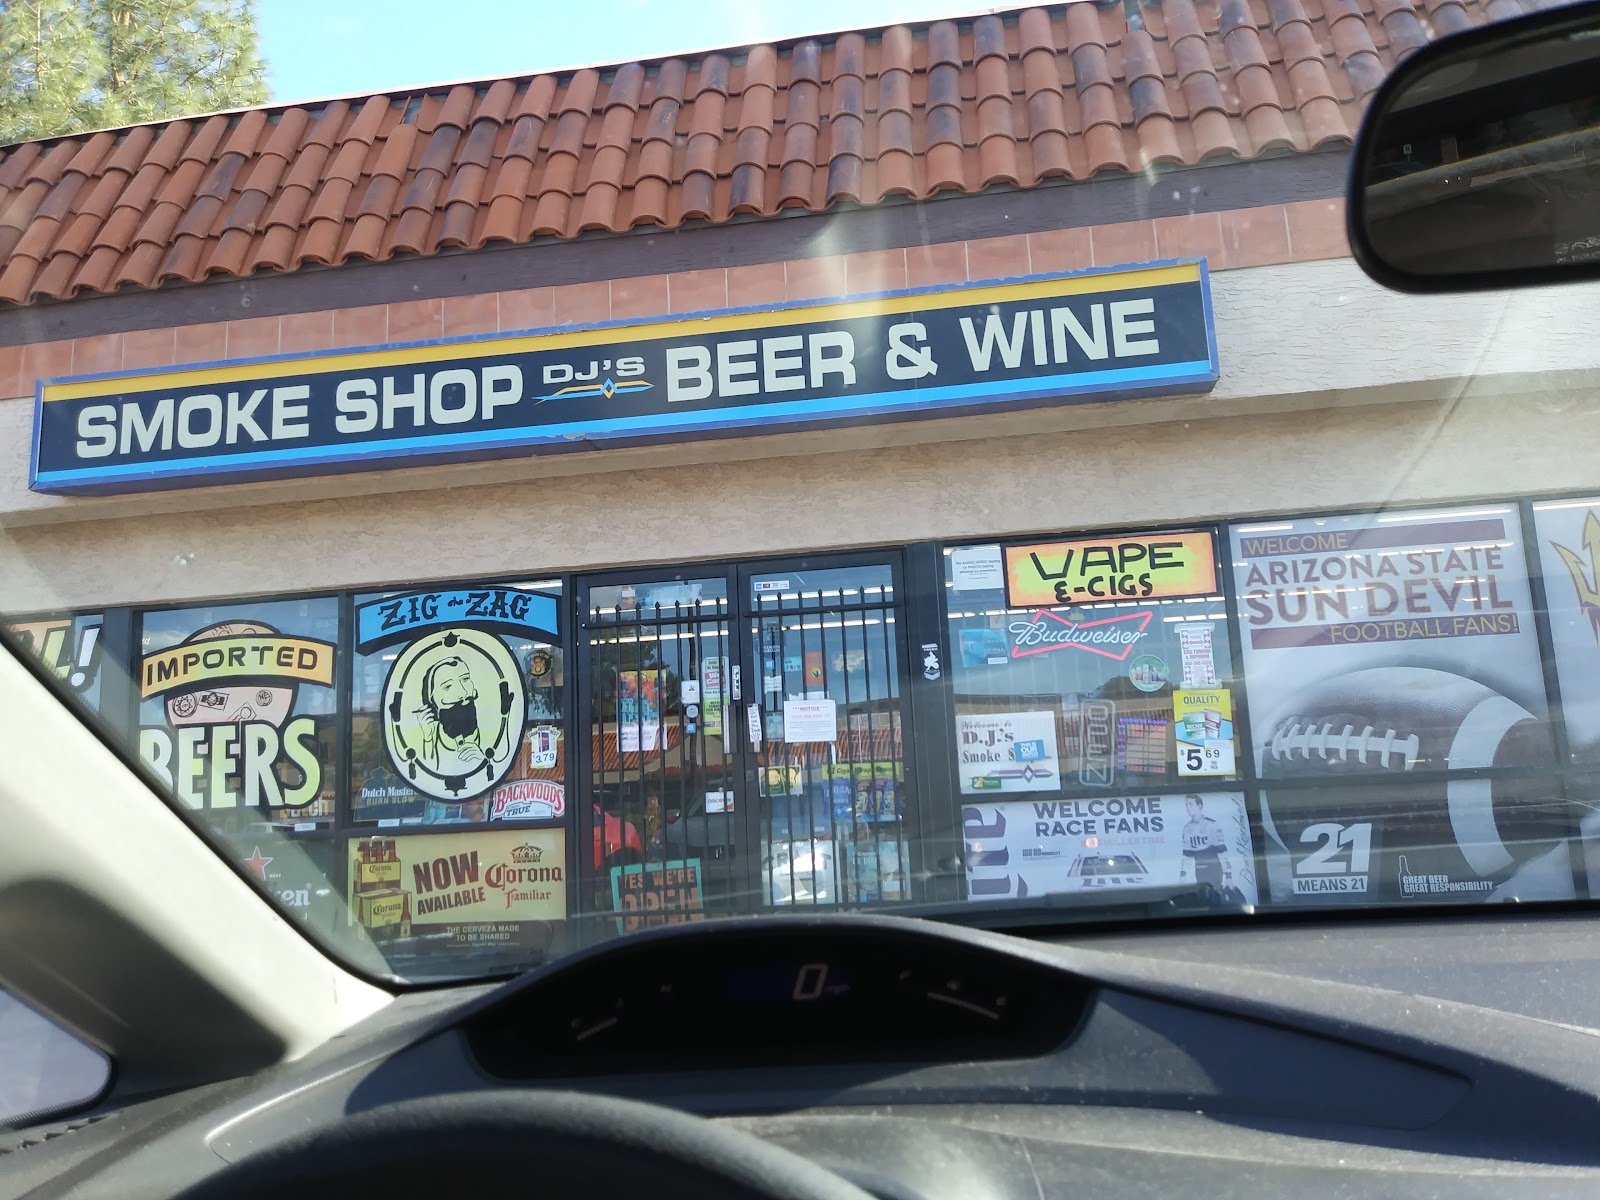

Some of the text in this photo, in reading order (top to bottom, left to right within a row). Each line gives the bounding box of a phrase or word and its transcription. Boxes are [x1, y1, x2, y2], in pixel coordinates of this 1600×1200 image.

[75, 297, 1160, 459] SMOKE SHOP DJ'S BEER & WINE
[1245, 532, 1348, 556] WELCOME
[1029, 541, 1185, 581] VAPE
[1245, 545, 1504, 587] ARIZONA STATE
[1054, 572, 1153, 603] E-CIGS
[377, 591, 532, 632] ZIG ZAG
[1248, 575, 1514, 626] SUN DEVIL
[1008, 620, 1148, 646] Budweiser
[1329, 614, 1518, 644] FOOTBALL FANS!
[146, 645, 318, 687] IMPORTED
[1183, 695, 1221, 705] QUALITY
[961, 720, 1000, 729] Welcome
[139, 718, 323, 810] BEERS
[962, 748, 1001, 764] Smoke
[361, 786, 386, 798] Dutch
[494, 782, 565, 813] BACKWOODS
[506, 804, 531, 816] TRUE
[1033, 797, 1162, 819] WELCOME
[1035, 816, 1165, 838] RACE FANS
[1296, 822, 1373, 875] 21
[368, 864, 392, 873] Corona
[412, 850, 480, 895] NOW
[484, 862, 564, 891] Corona
[651, 867, 696, 887] WE'RE
[1402, 874, 1449, 885] GREAT BEER
[1297, 877, 1366, 893] MEANS 21
[1403, 880, 1494, 894] GREAT RESPONSIBILITY
[372, 903, 402, 916] Corona
[417, 886, 486, 916] AVAILABLE
[504, 888, 552, 910] Familiar
[446, 924, 520, 934] THE CERVEZA MADE
[793, 963, 830, 1000] 0
